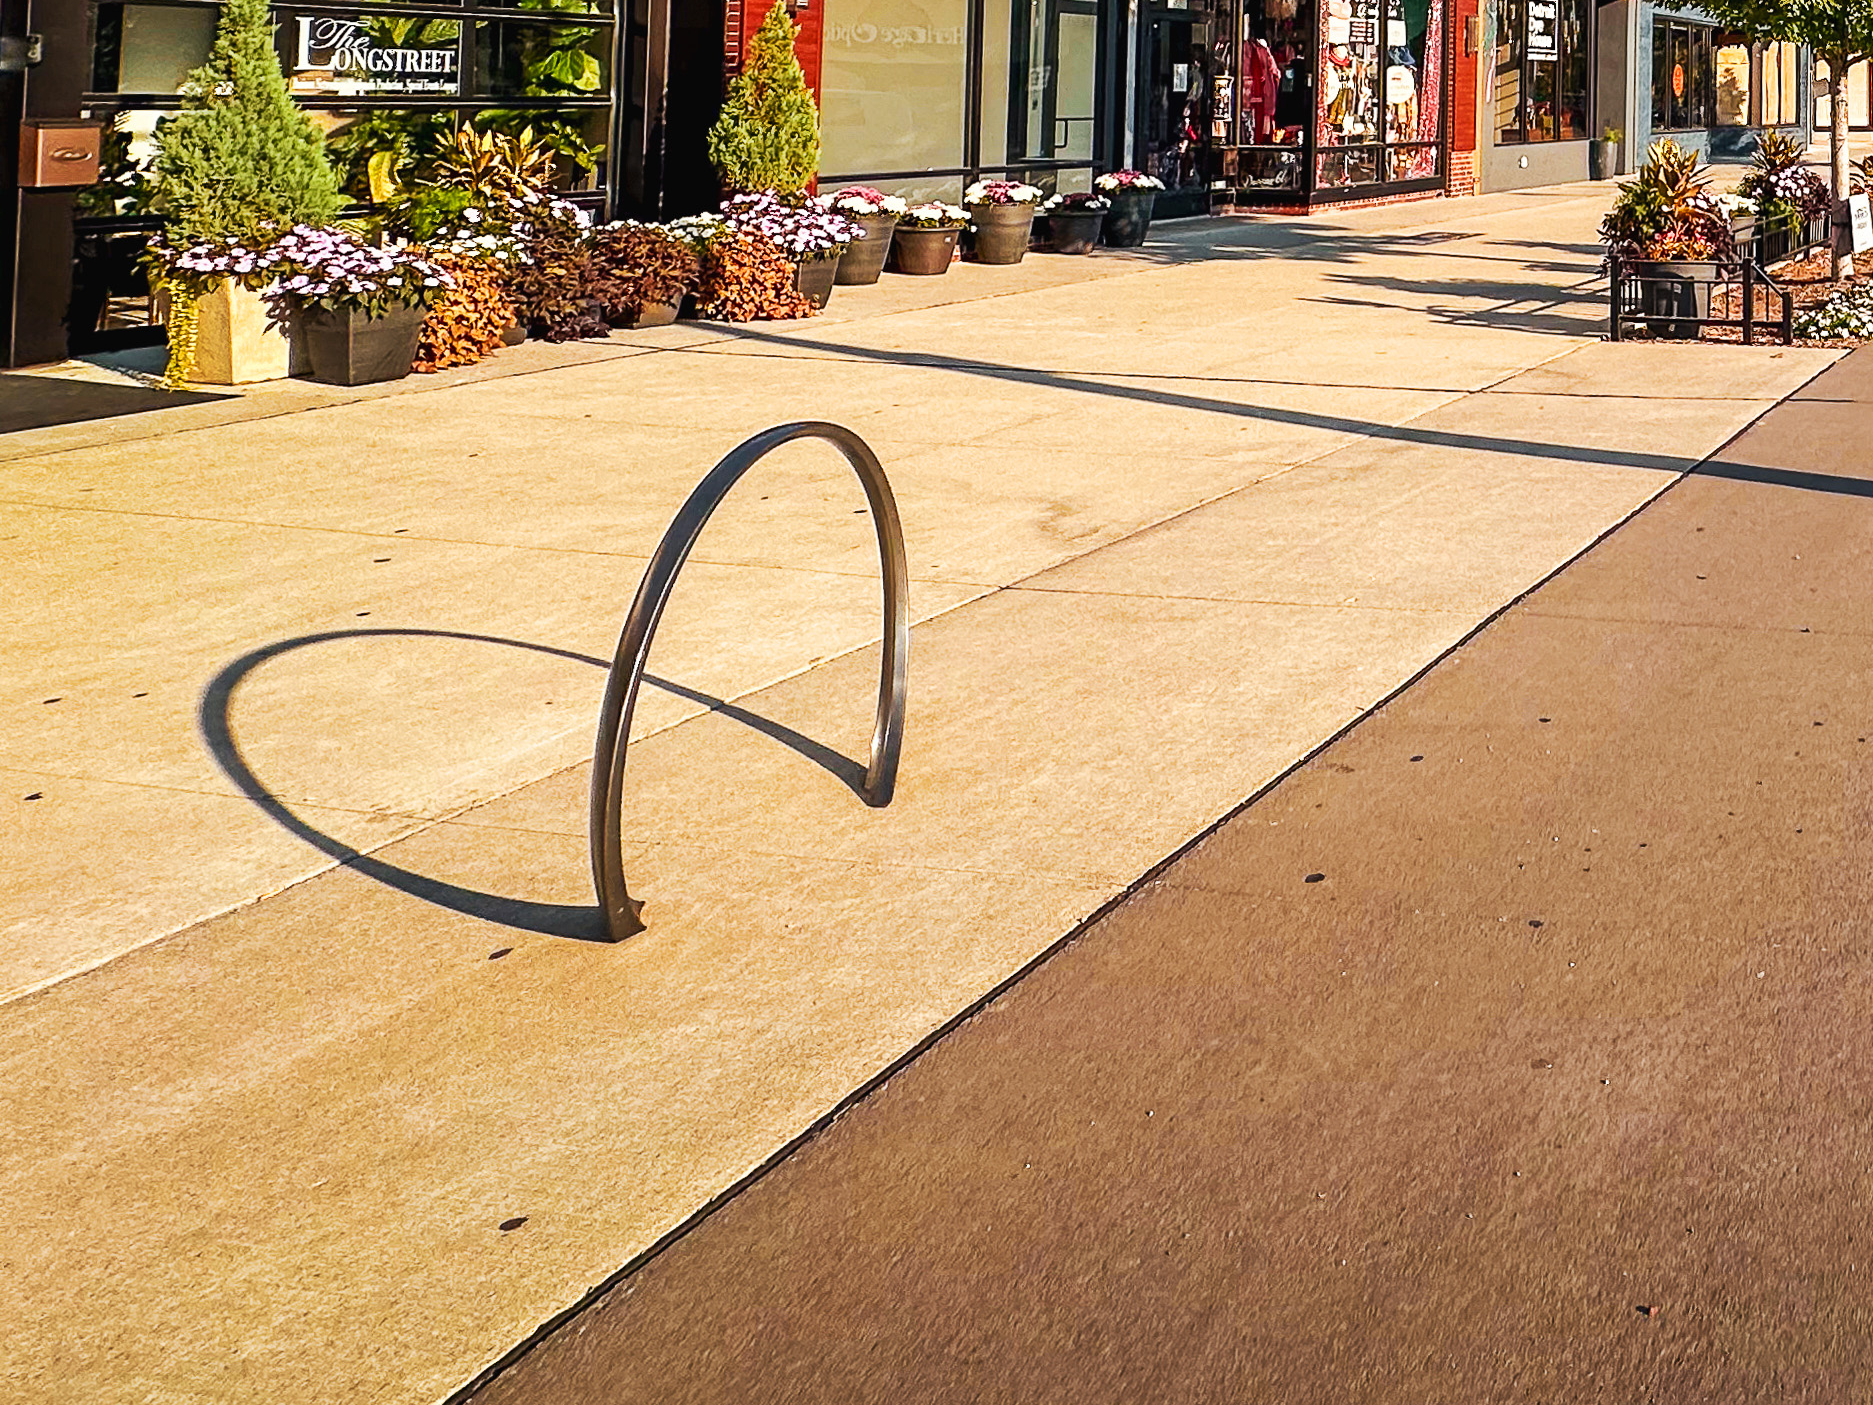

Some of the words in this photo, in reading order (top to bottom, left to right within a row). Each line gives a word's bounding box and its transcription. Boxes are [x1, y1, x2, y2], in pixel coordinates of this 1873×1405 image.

[1529, 1, 1555, 19] Detroit
[293, 16, 455, 73] LONGSTREET
[310, 17, 371, 49] The
